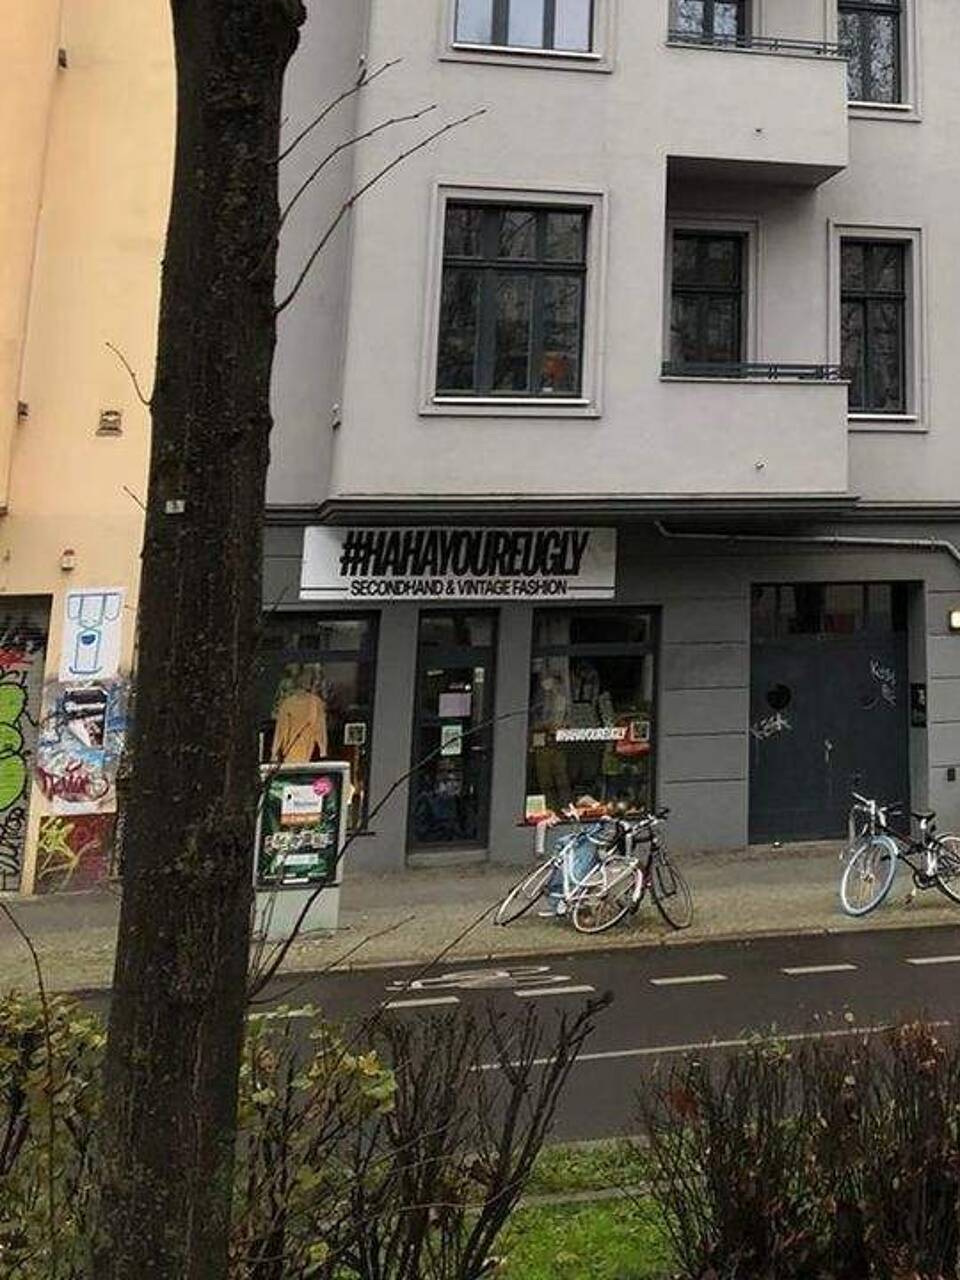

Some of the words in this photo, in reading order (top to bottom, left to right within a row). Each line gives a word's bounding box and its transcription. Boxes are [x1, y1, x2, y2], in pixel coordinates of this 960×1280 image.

[340, 529, 589, 576] #HAHAYOUREUGLY
[350, 580, 443, 597] SECONDHAND
[446, 581, 455, 596] &
[457, 580, 511, 596] VINTAGE
[512, 580, 568, 596] FASHION
